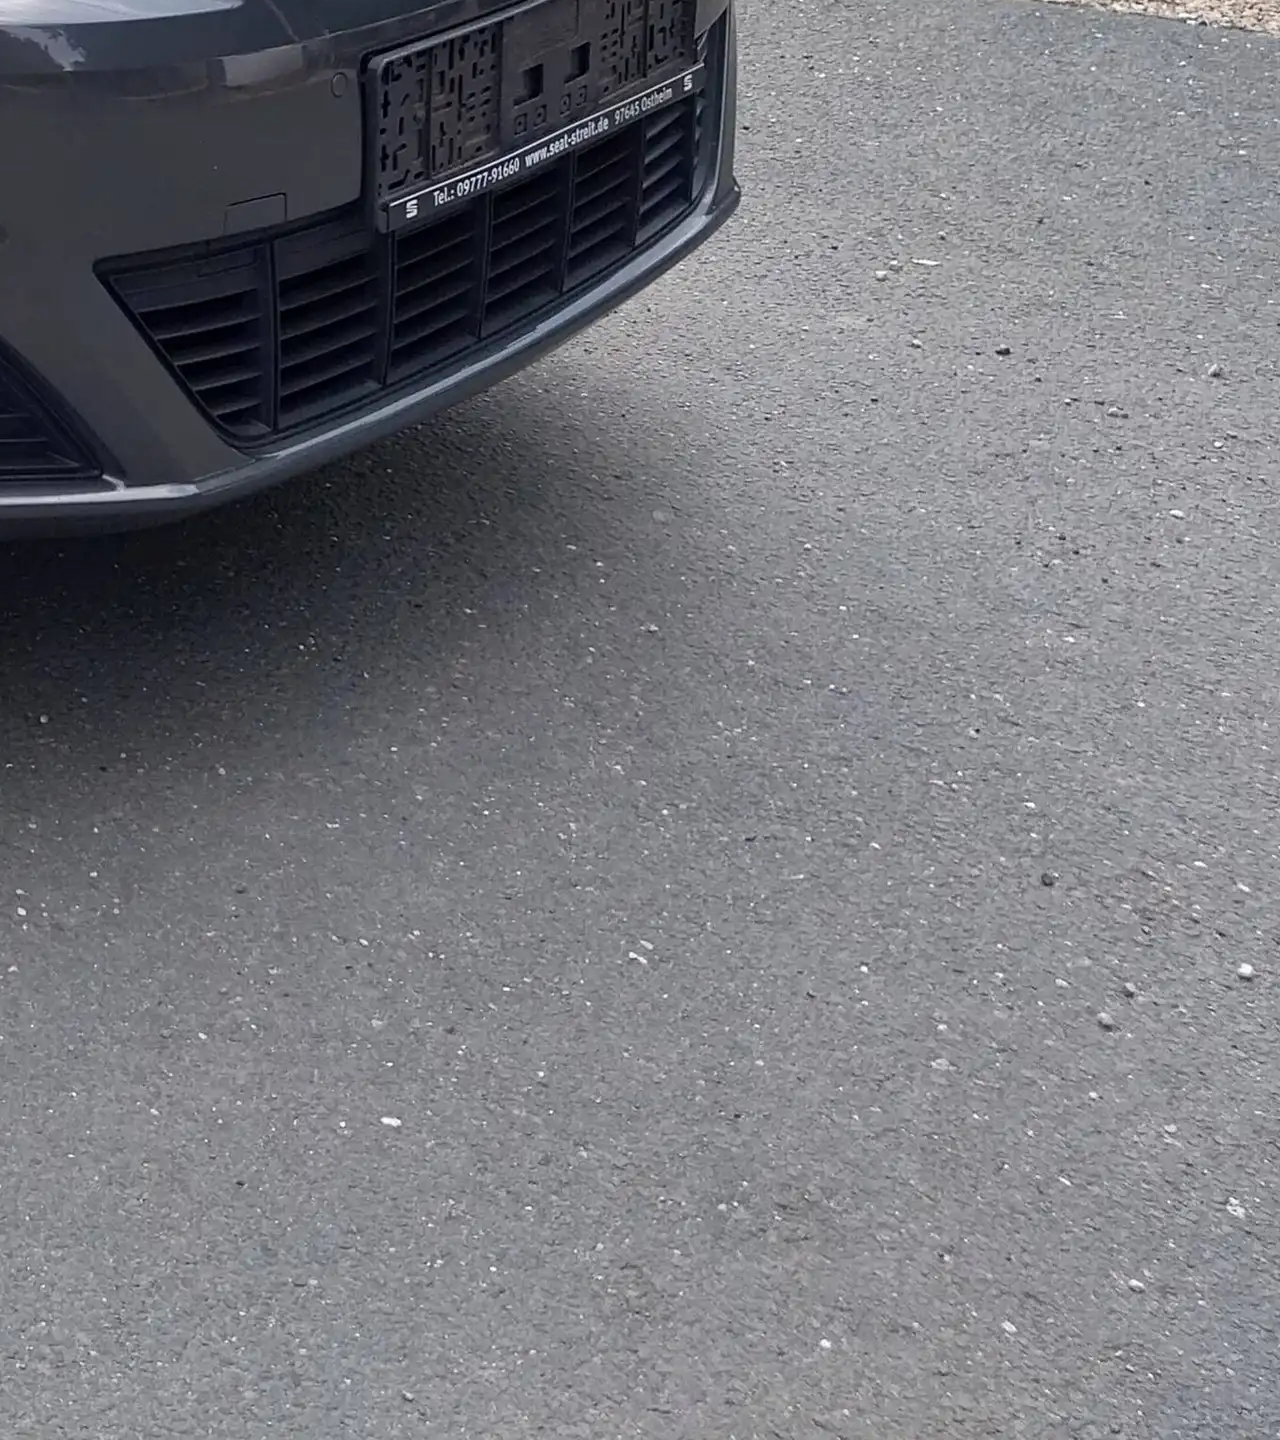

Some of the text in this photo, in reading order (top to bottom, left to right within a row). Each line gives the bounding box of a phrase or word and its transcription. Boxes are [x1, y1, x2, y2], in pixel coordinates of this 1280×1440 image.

[433, 187, 455, 206] Tel.:
[456, 157, 520, 197] 09777-91660
[524, 117, 609, 167] www.seat-streit.de
[614, 101, 640, 125] 97645
[641, 87, 673, 112] Ostheim
